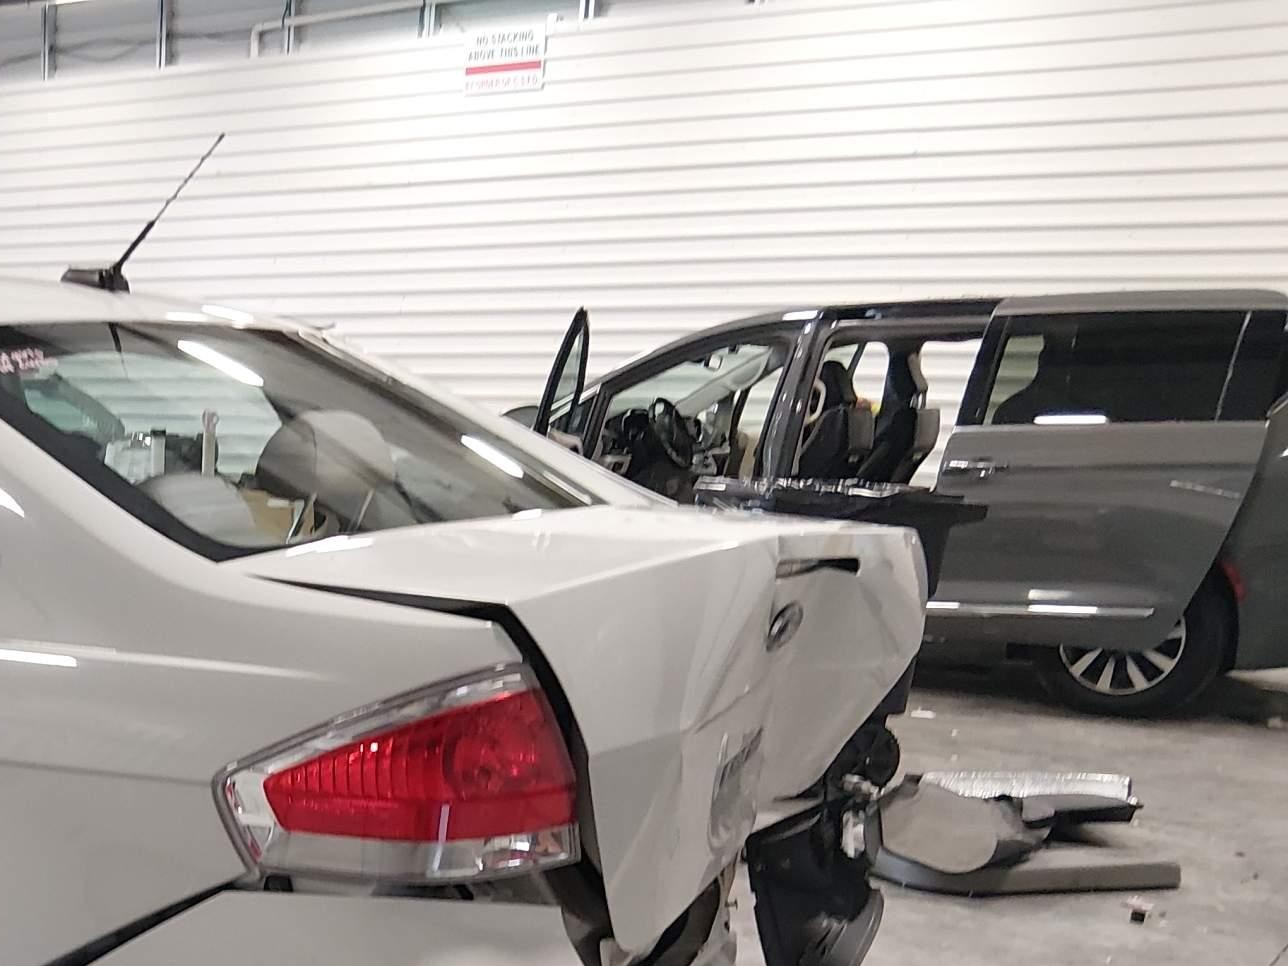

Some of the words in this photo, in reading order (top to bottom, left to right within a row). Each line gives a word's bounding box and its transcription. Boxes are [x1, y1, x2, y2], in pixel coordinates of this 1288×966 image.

[476, 35, 489, 48] NO
[491, 29, 535, 45] STACKING
[468, 48, 495, 62] ABOVE
[500, 46, 519, 58] THIS
[521, 44, 540, 57] LINE
